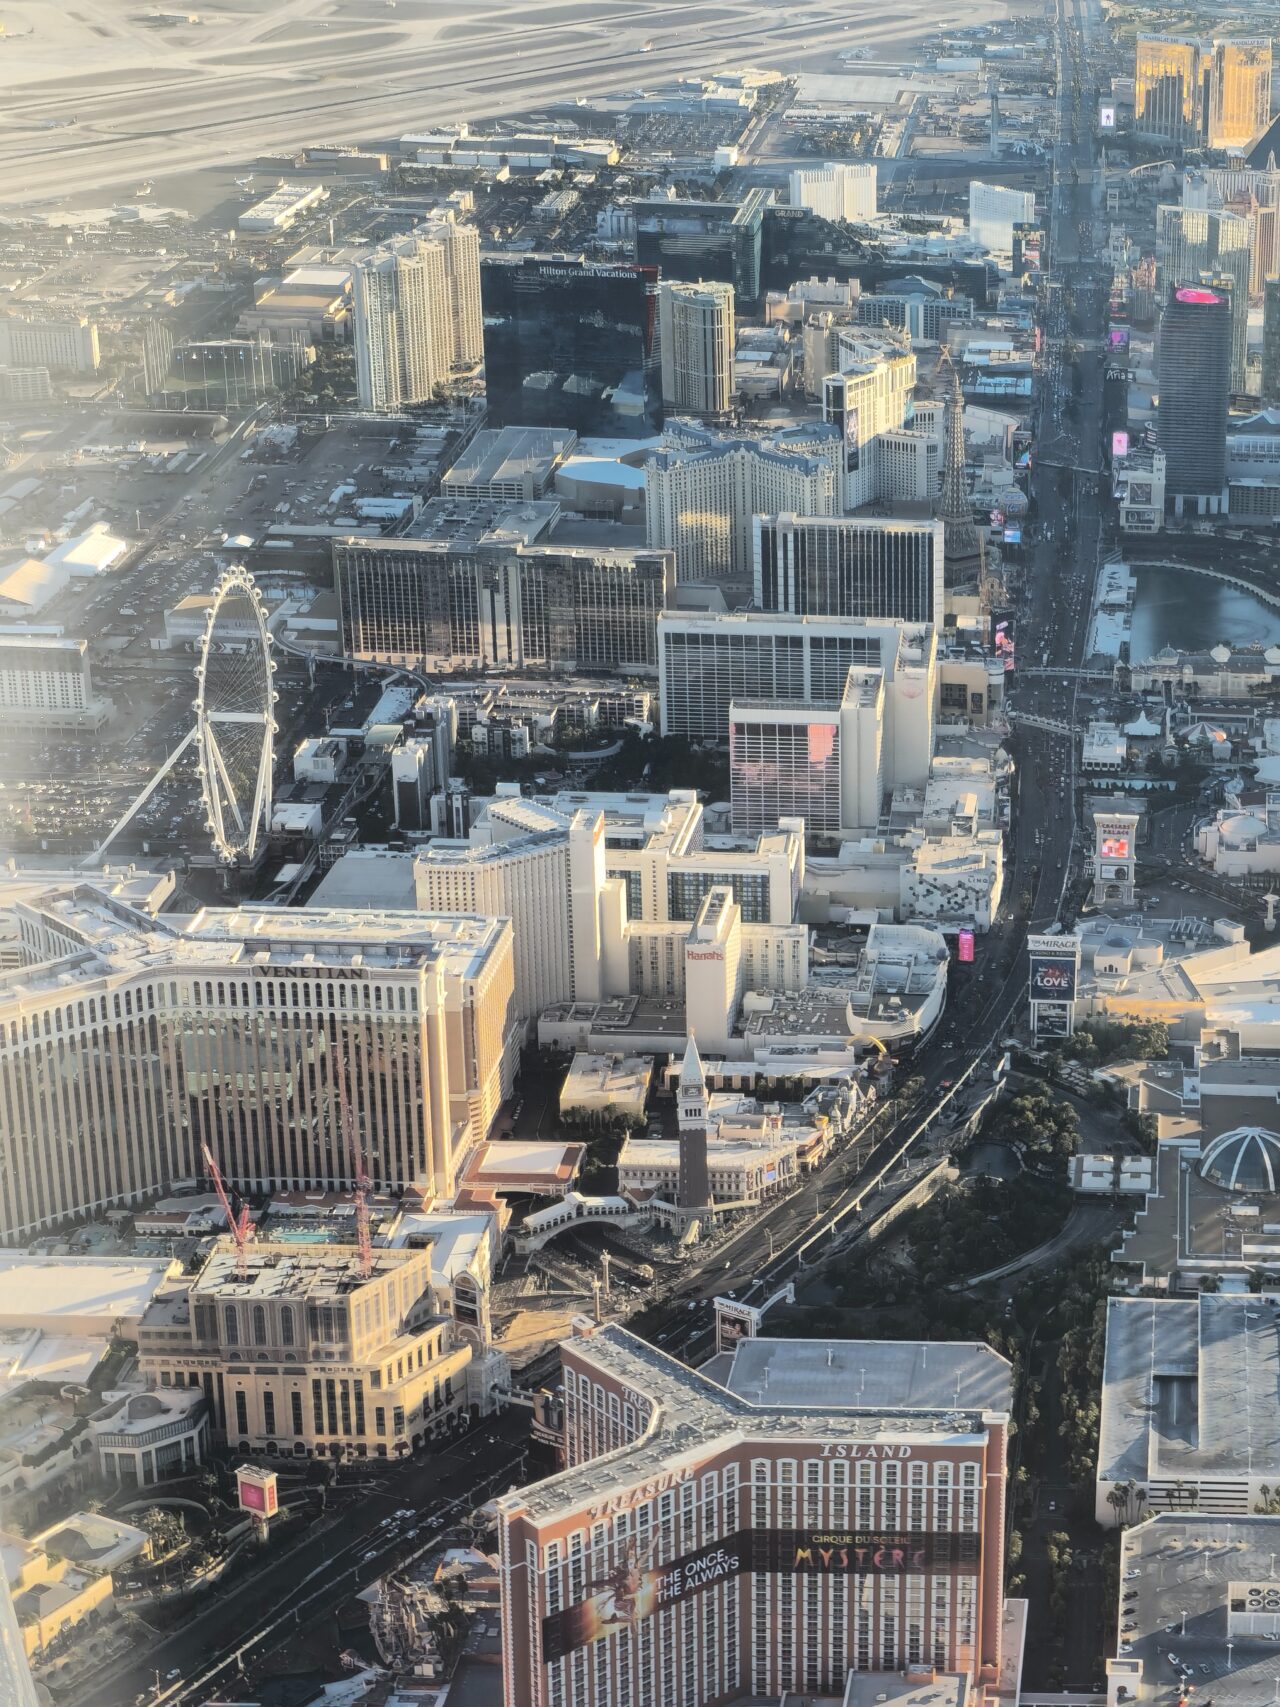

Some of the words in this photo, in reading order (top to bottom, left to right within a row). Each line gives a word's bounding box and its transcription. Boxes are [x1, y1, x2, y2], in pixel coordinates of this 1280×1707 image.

[775, 210, 803, 218] GRAND
[540, 266, 566, 275] Hilton
[568, 268, 594, 276] Grand
[596, 269, 637, 278] Vacations
[1106, 370, 1125, 380] Aria
[1040, 939, 1077, 948] MIRAGE
[260, 965, 362, 979] VENETIAN
[1037, 977, 1069, 987] LOVE
[820, 1444, 912, 1458] ISLAND
[590, 1466, 696, 1519] TREASURE
[812, 1535, 853, 1545] CIRQUE
[873, 1536, 912, 1544] SOLEIL
[656, 1568, 682, 1590] THE
[684, 1549, 728, 1576] ONCE,
[656, 1582, 682, 1603] THE
[685, 1556, 740, 1591] ALWAYS
